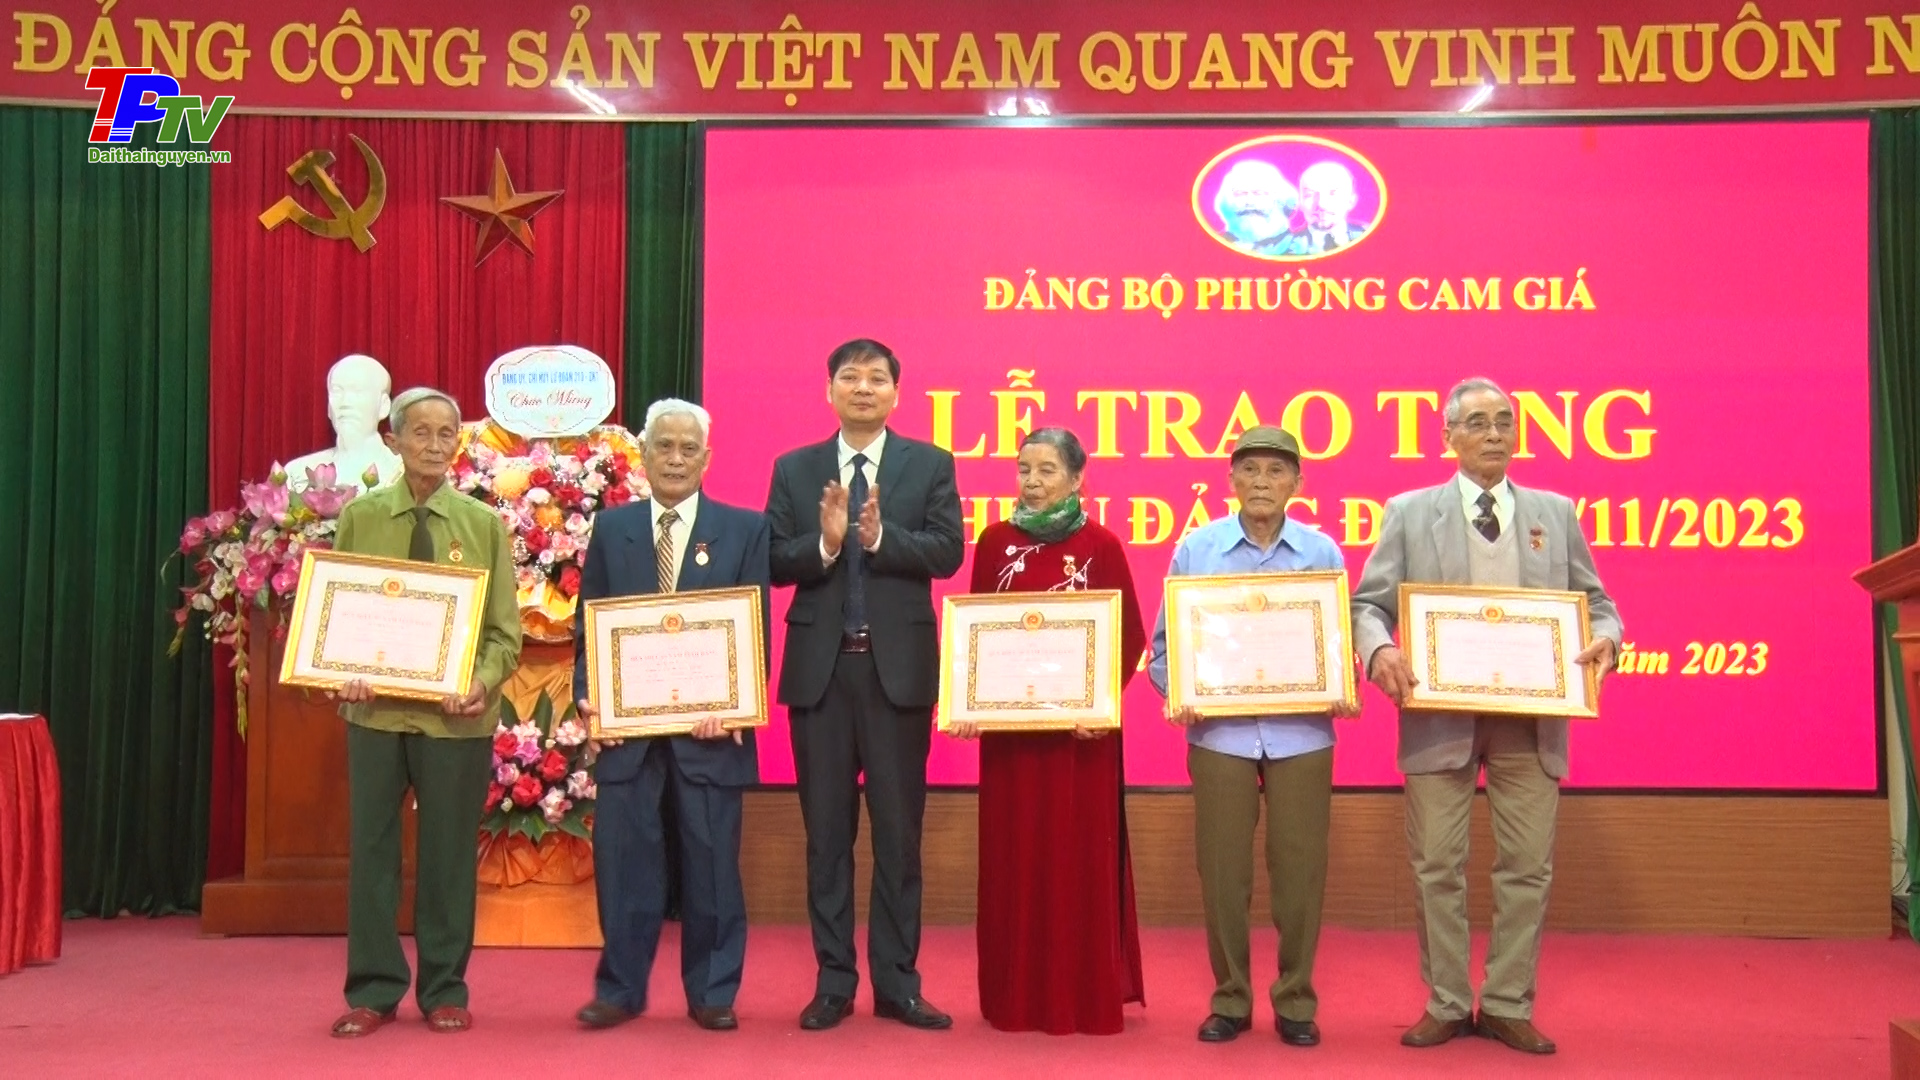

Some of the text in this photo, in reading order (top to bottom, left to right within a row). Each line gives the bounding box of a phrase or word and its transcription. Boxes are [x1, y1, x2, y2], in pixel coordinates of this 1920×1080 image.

[13, 0, 251, 82] ĐẢNG
[269, 8, 486, 100] CỘNG
[506, 5, 661, 89] SẢN
[683, 13, 861, 107] VIỆT
[883, 32, 1061, 90] NAM
[1079, 30, 1353, 94] QUANG
[1374, 27, 1576, 88] VINH
[1597, 1, 1842, 83] MUÔN
[983, 267, 1597, 320] ĐẢNG BỘ PHƯỜNG CAM GIÁ
[925, 368, 1658, 461] LỄ TRAO TNG
[1680, 641, 1769, 676] 2023
